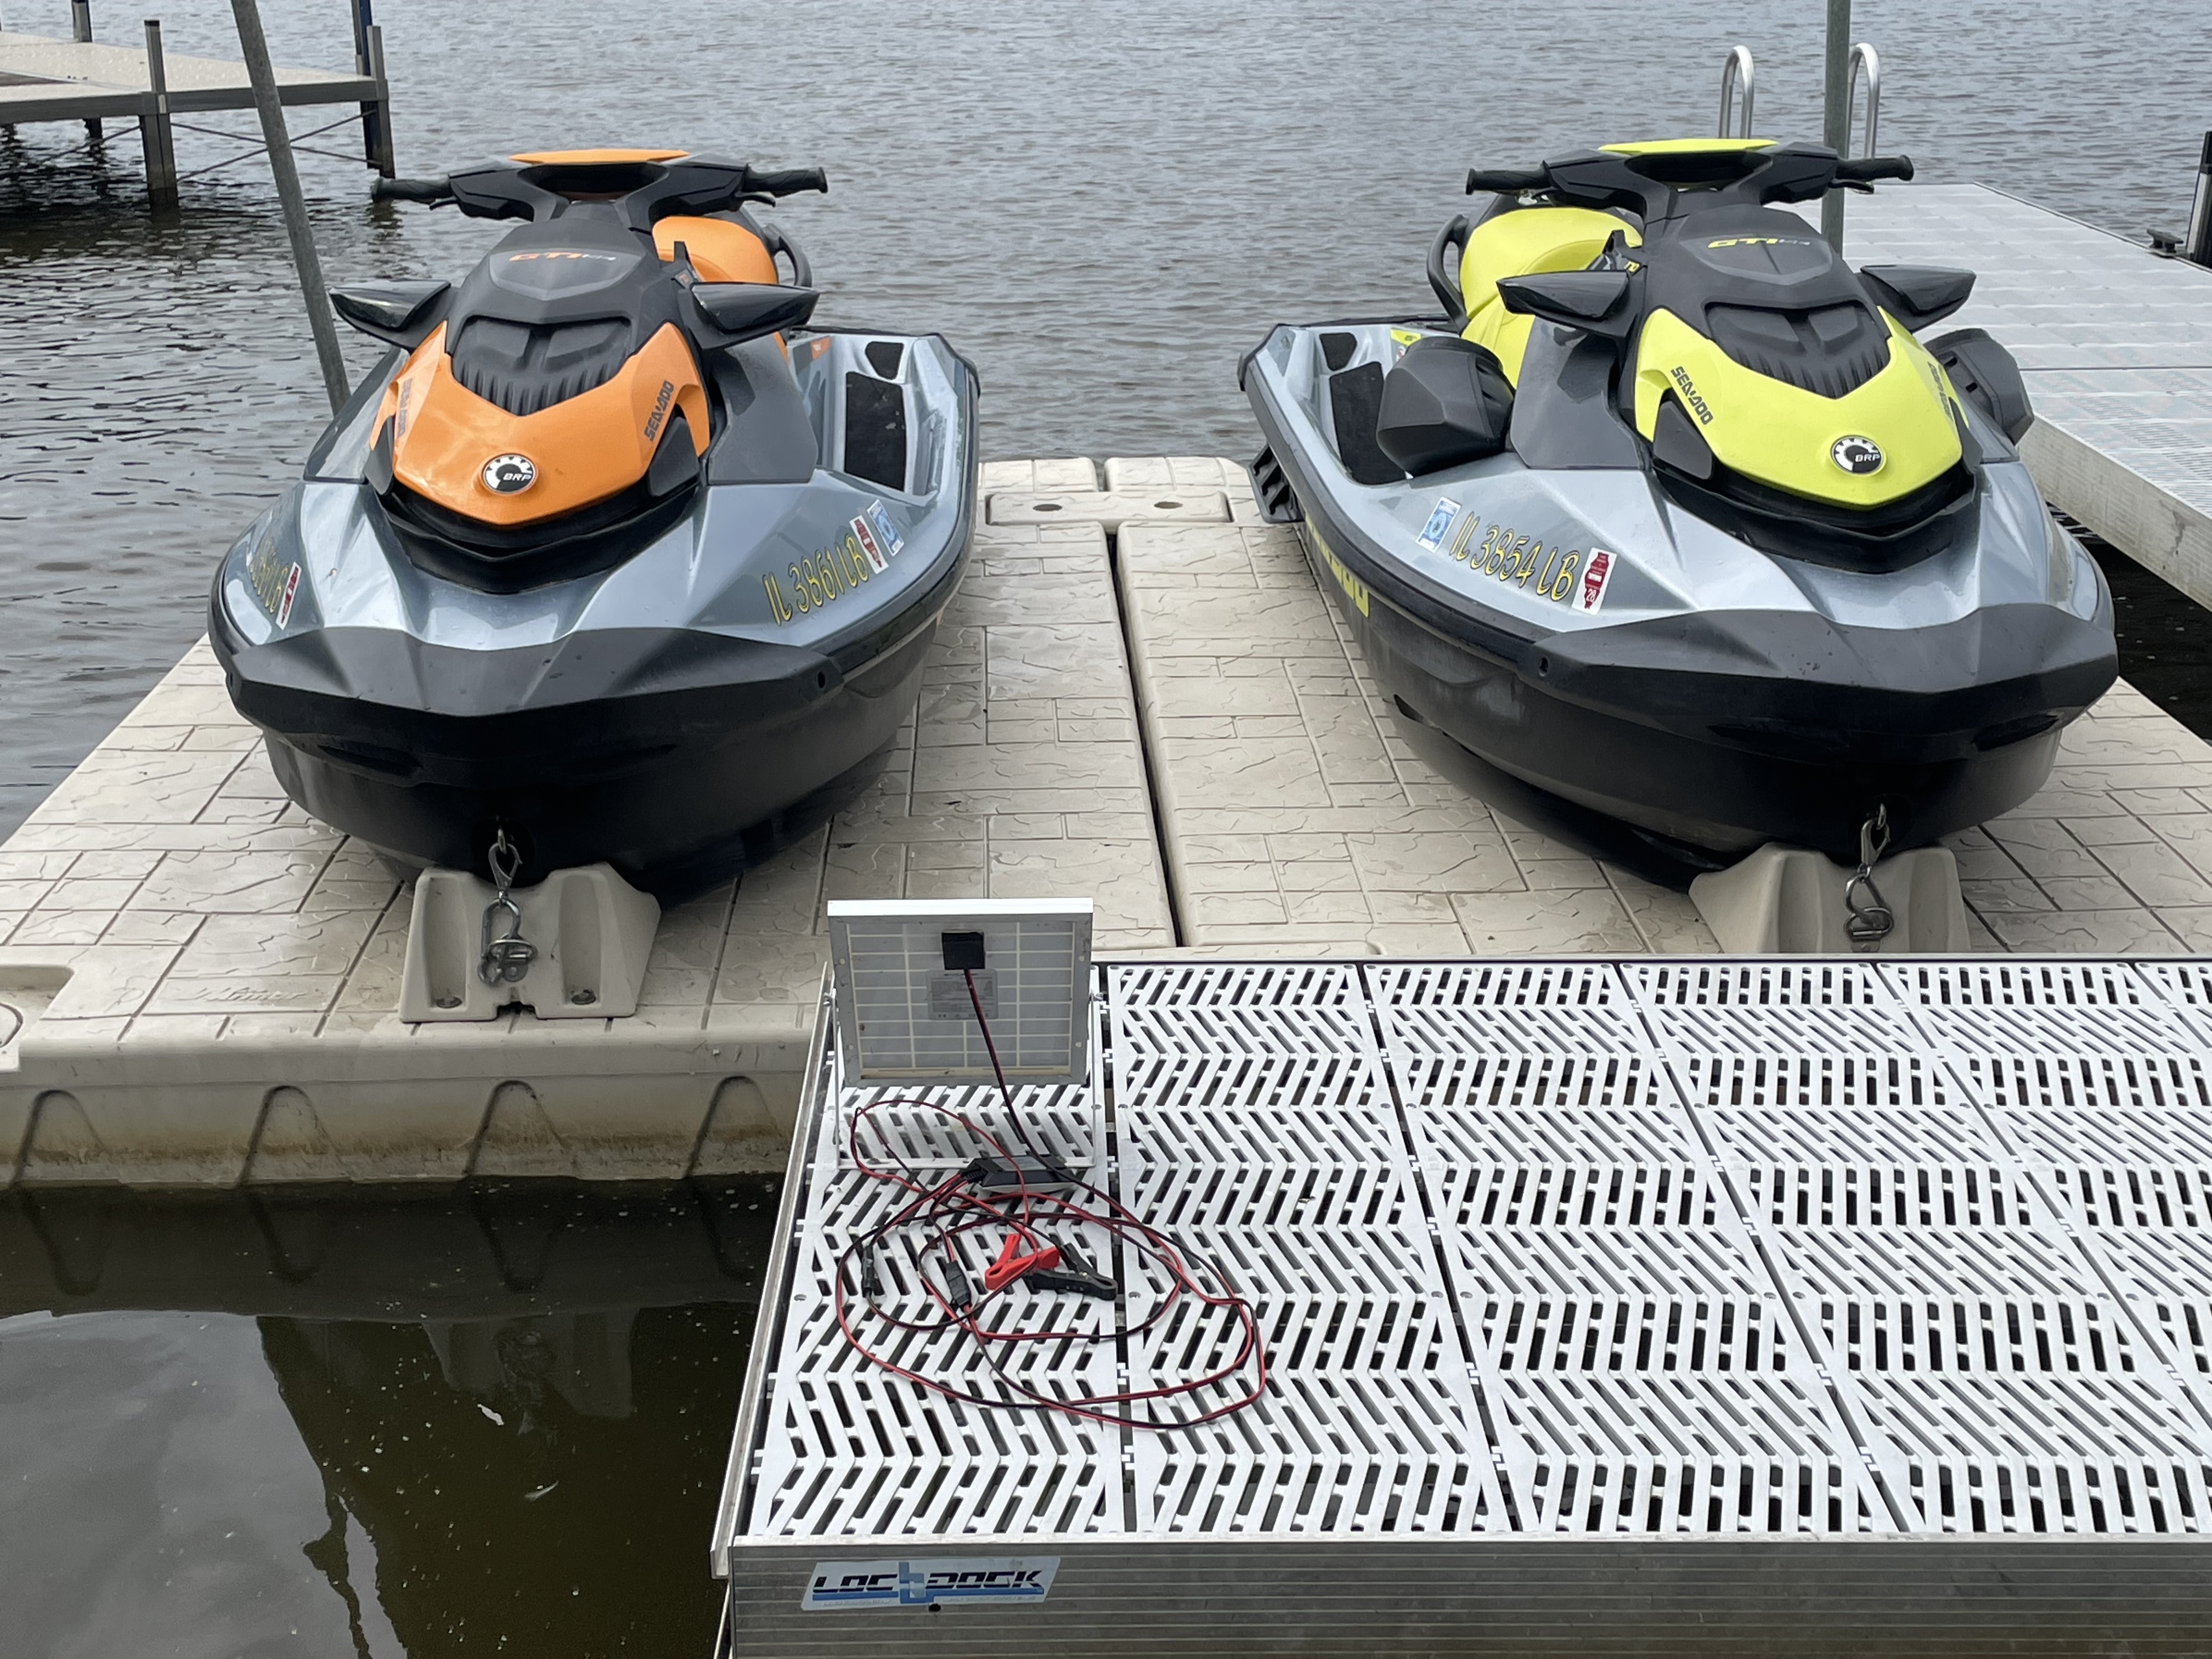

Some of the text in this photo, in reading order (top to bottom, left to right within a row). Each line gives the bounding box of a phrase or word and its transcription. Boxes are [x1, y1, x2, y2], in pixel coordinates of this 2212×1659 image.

[1855, 454, 1881, 462] BRP
[503, 472, 532, 481] BRP
[1449, 510, 1481, 561] IL
[1470, 524, 1543, 589] 3854
[1536, 546, 1580, 602] LB
[761, 571, 793, 627] IL
[787, 545, 845, 614] 3861
[834, 533, 869, 588] LB
[925, 1570, 1042, 1590] DOCK
